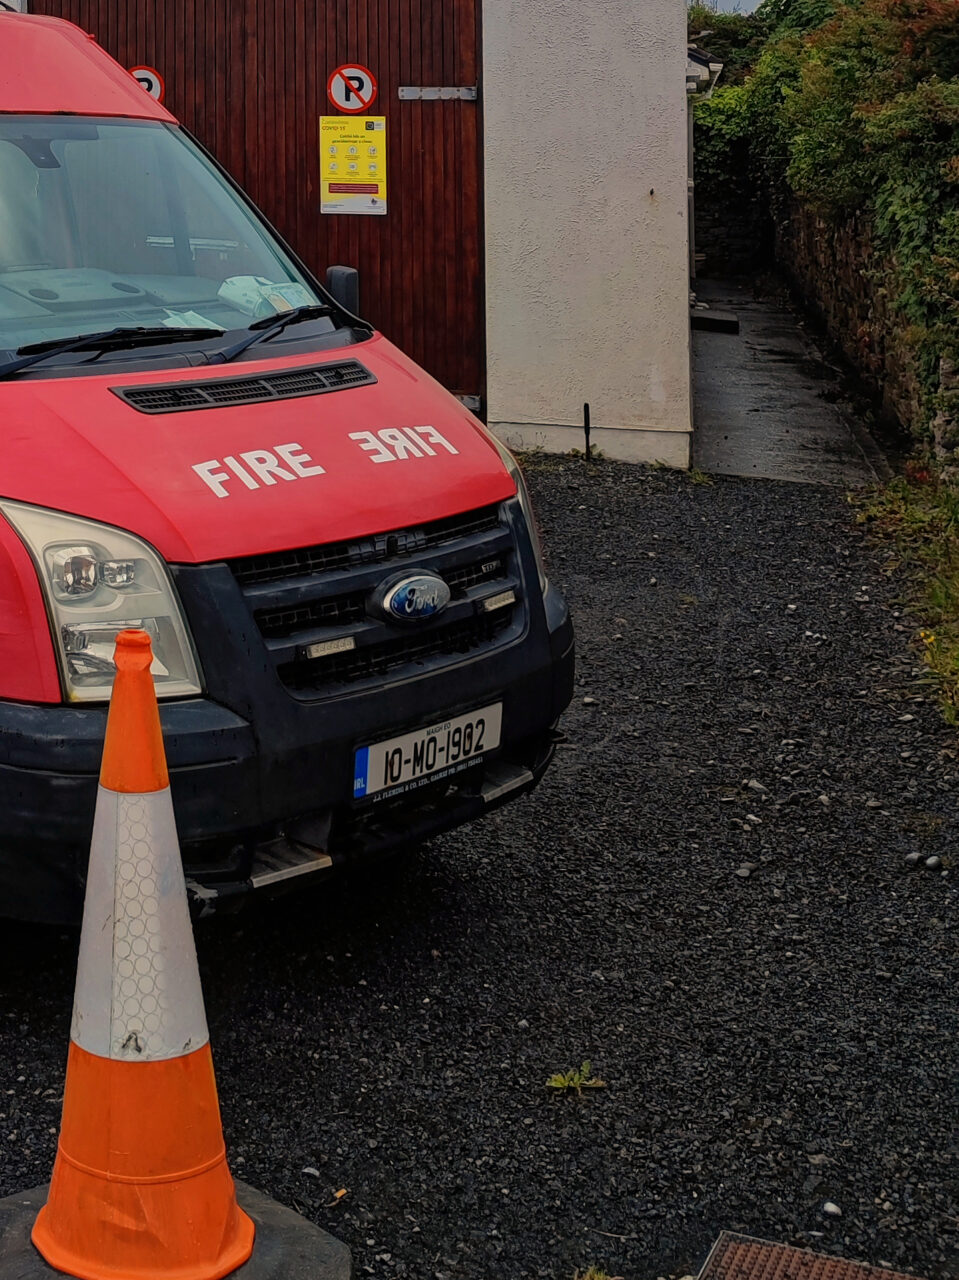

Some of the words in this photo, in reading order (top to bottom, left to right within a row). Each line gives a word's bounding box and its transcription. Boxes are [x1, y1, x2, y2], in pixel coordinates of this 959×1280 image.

[191, 443, 327, 498] FIRE
[405, 585, 440, 614] Ford
[383, 718, 486, 786] 10-MO-1902
[354, 777, 366, 790] IRL
